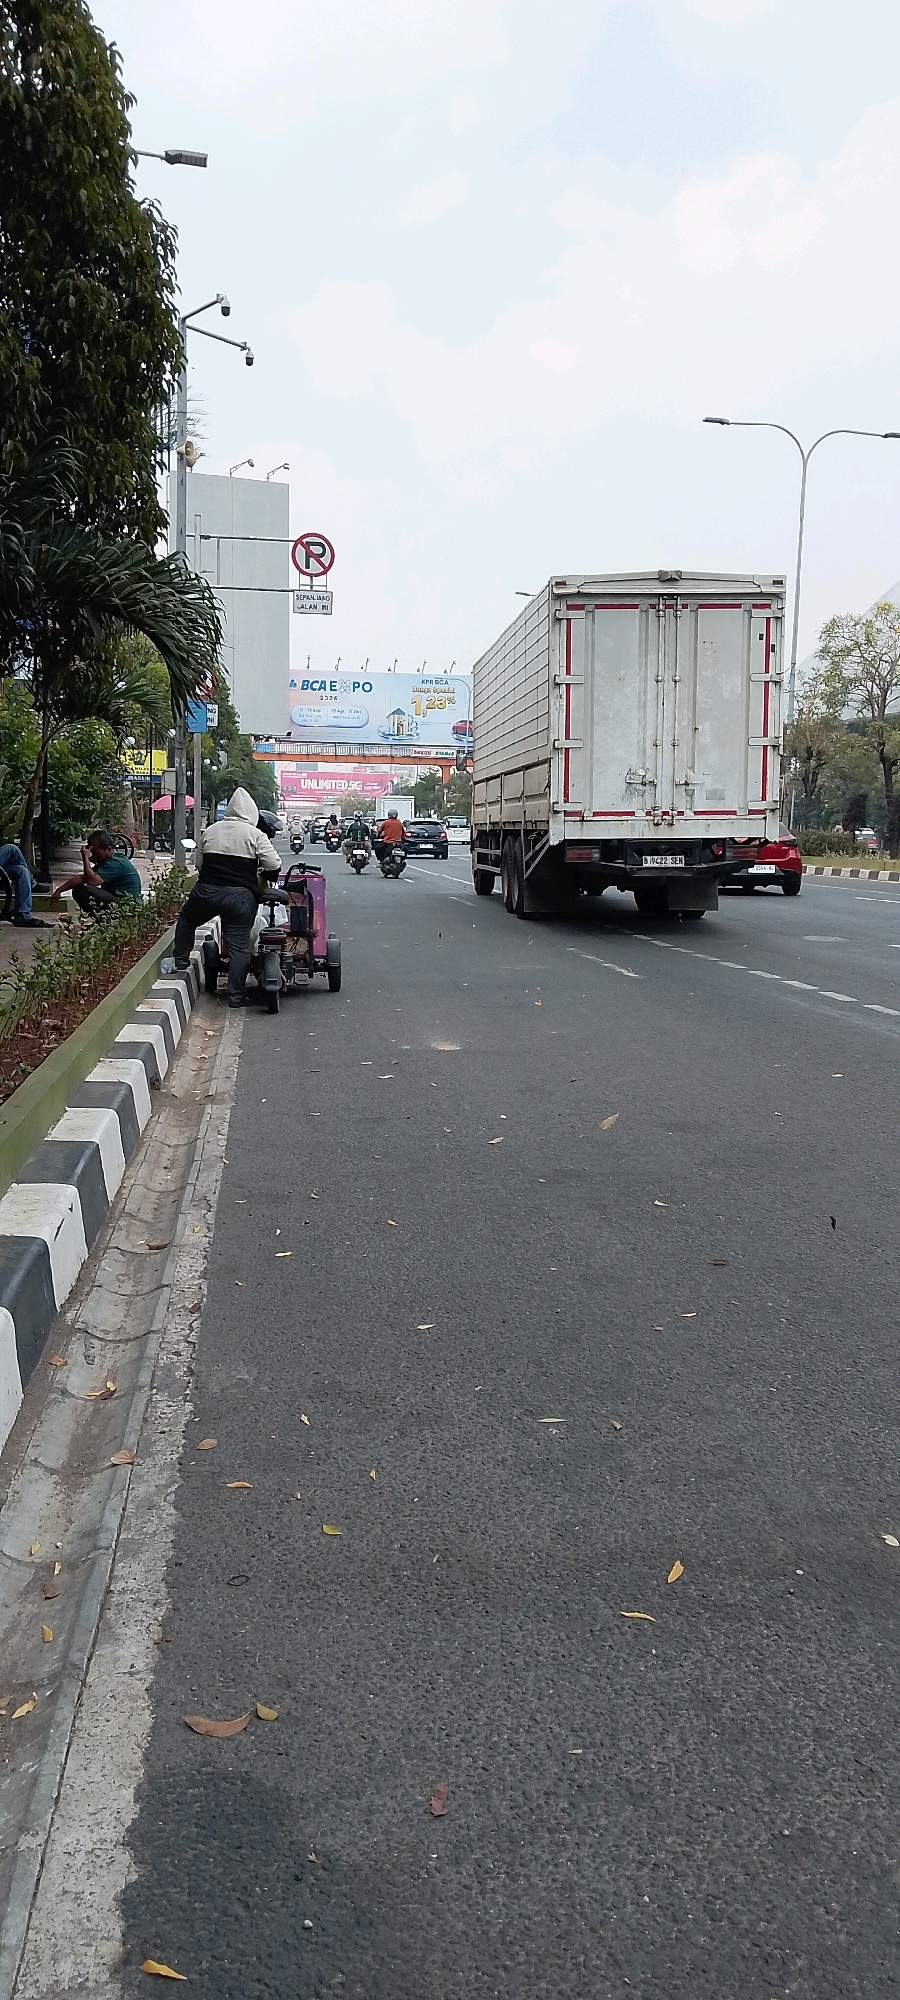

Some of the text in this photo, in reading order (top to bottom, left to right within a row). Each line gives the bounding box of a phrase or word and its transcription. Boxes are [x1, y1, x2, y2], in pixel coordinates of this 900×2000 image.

[304, 541, 327, 569] P
[297, 603, 318, 611] JALAN
[300, 679, 373, 694] BCA EXPO
[411, 694, 457, 718] 1,23%
[300, 778, 348, 790] UNLIMITED
[644, 856, 648, 865] B
